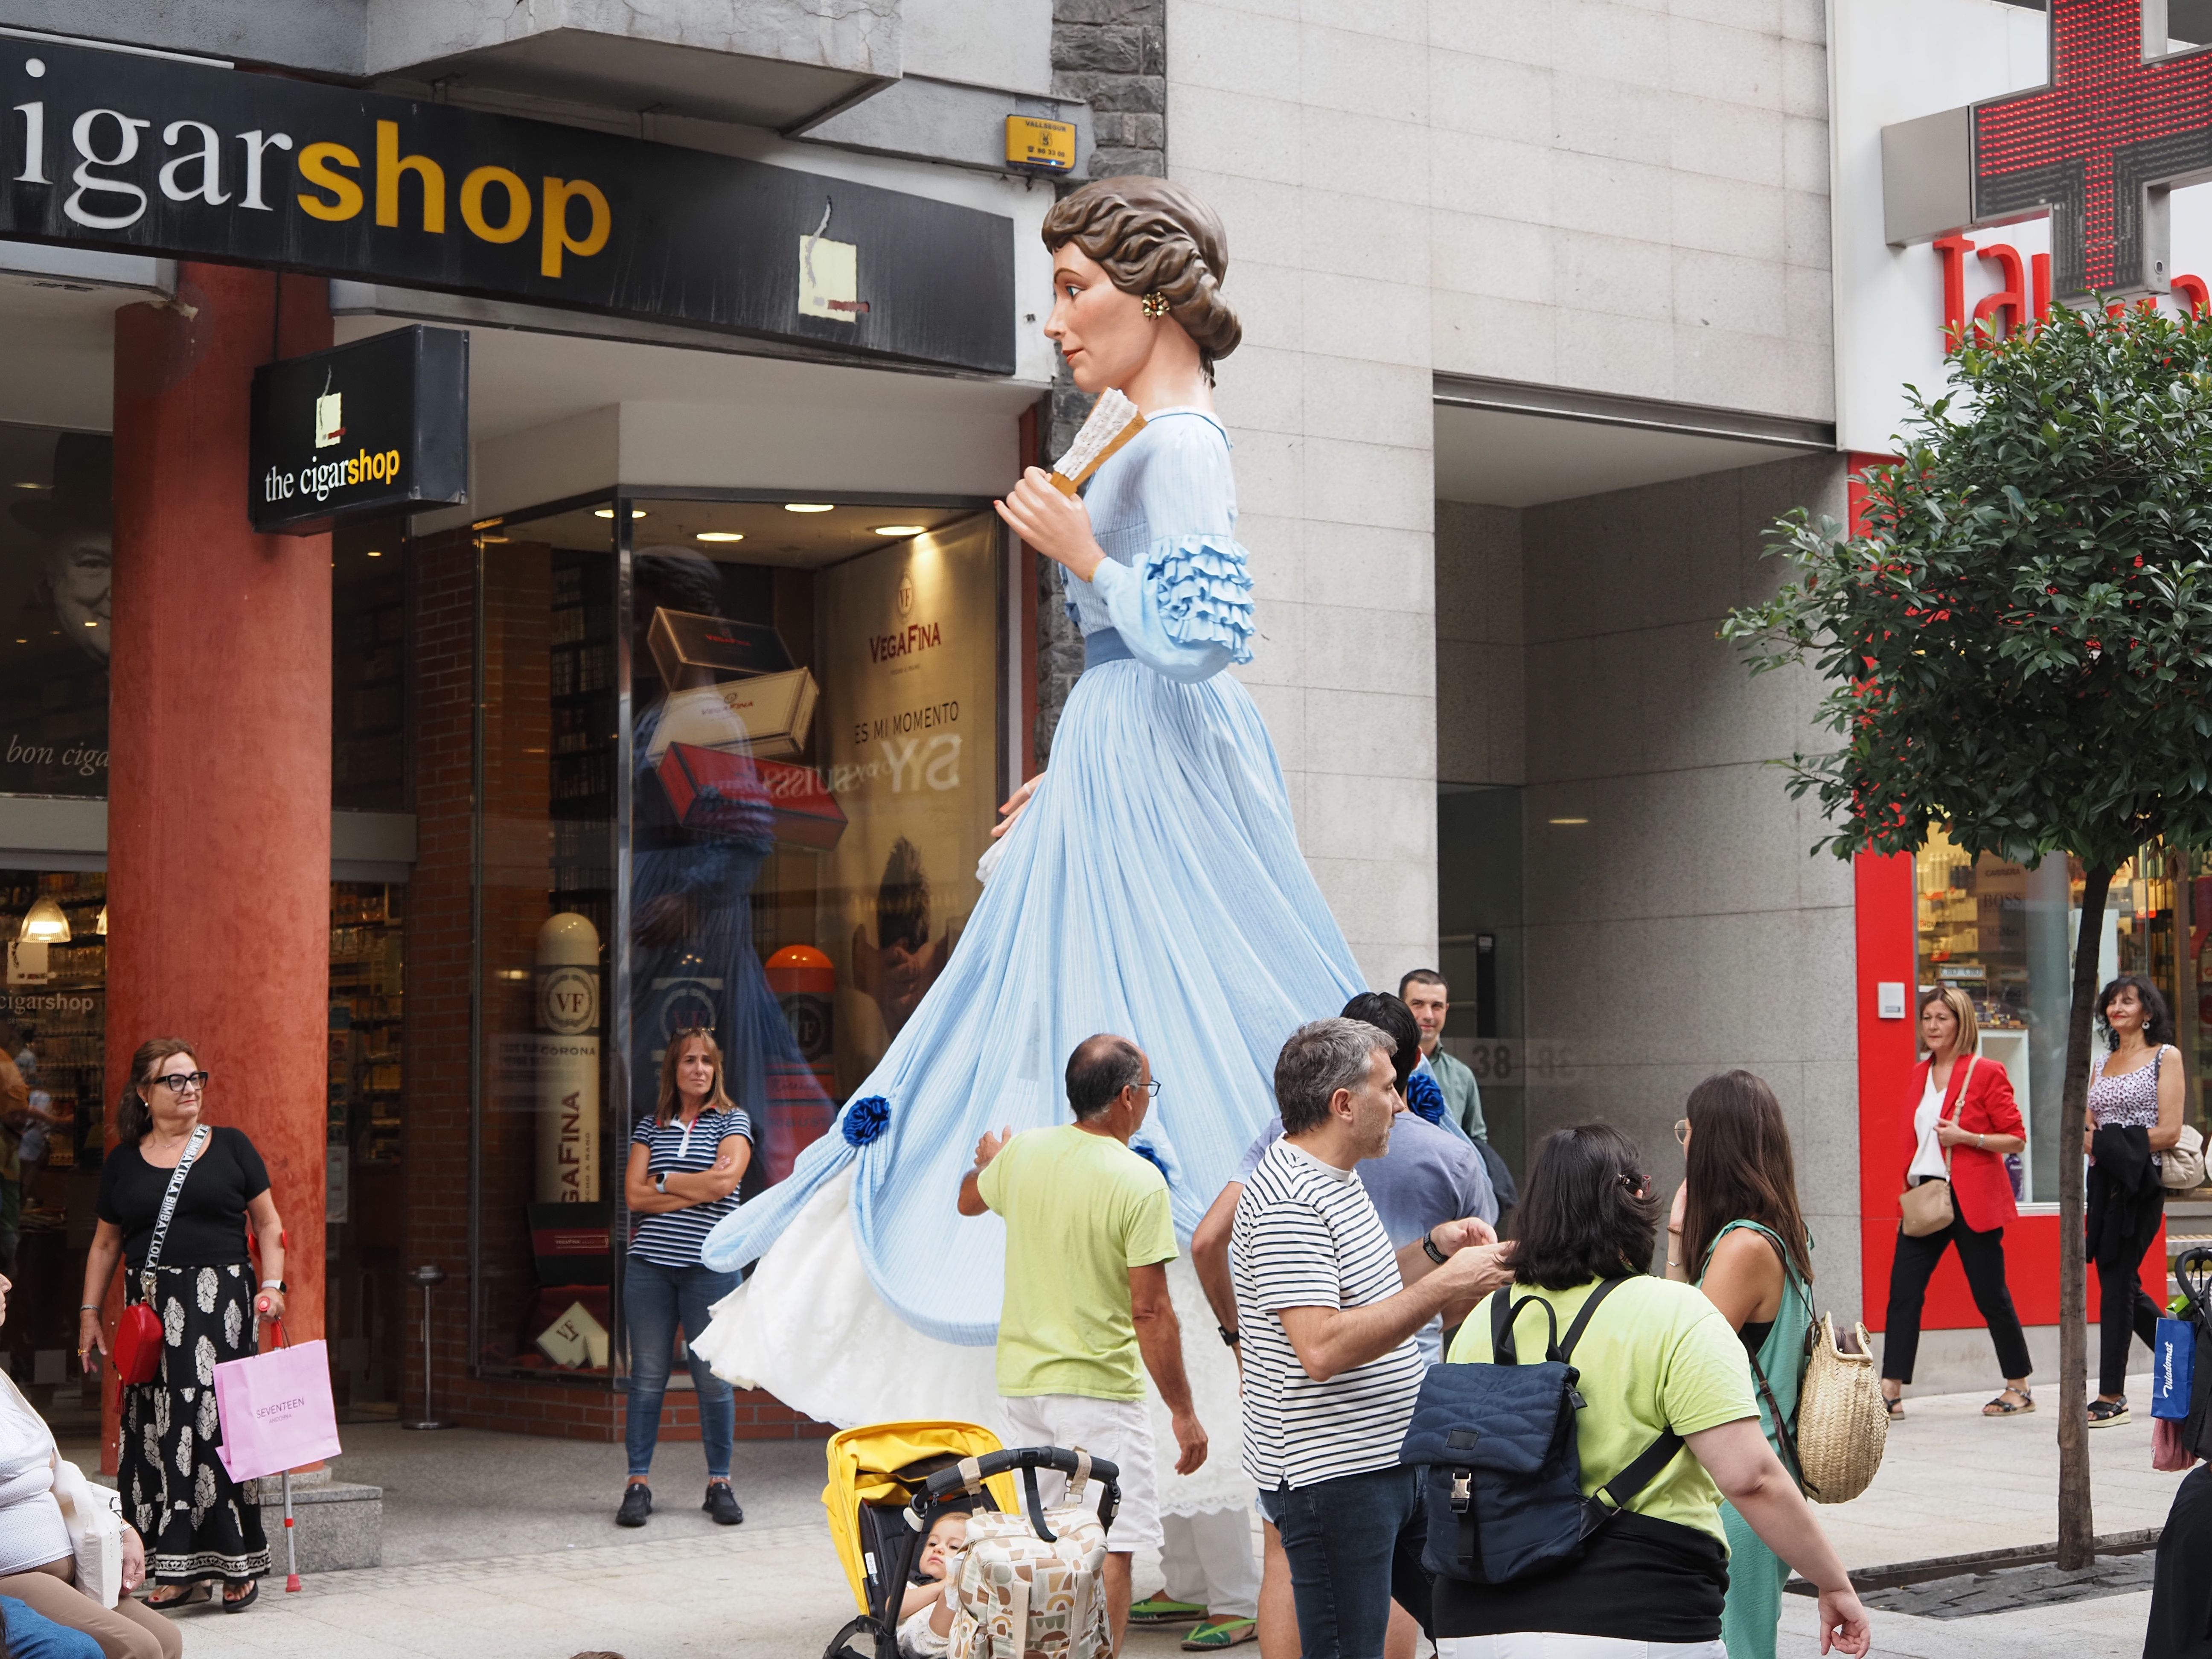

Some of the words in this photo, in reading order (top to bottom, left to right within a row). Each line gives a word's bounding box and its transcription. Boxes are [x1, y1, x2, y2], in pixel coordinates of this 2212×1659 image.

[265, 466, 294, 502] the
[300, 448, 400, 501] cigarshop
[899, 588, 911, 608] VF
[855, 723, 867, 744] ES
[874, 717, 888, 740] MI
[894, 701, 959, 735] MOMENTO
[6, 734, 53, 764] bon
[0, 990, 93, 1014] cigarshop
[556, 993, 583, 1013] VF
[541, 1047, 595, 1056] CORONA
[1473, 1045, 1512, 1079] 38
[169, 1169, 186, 1193] LOLA
[146, 1240, 161, 1268] LOLA
[2163, 1341, 2173, 1399] Viladomat
[256, 1397, 304, 1419] SEVENTEEN
[269, 1414, 292, 1424] ANDORRA
